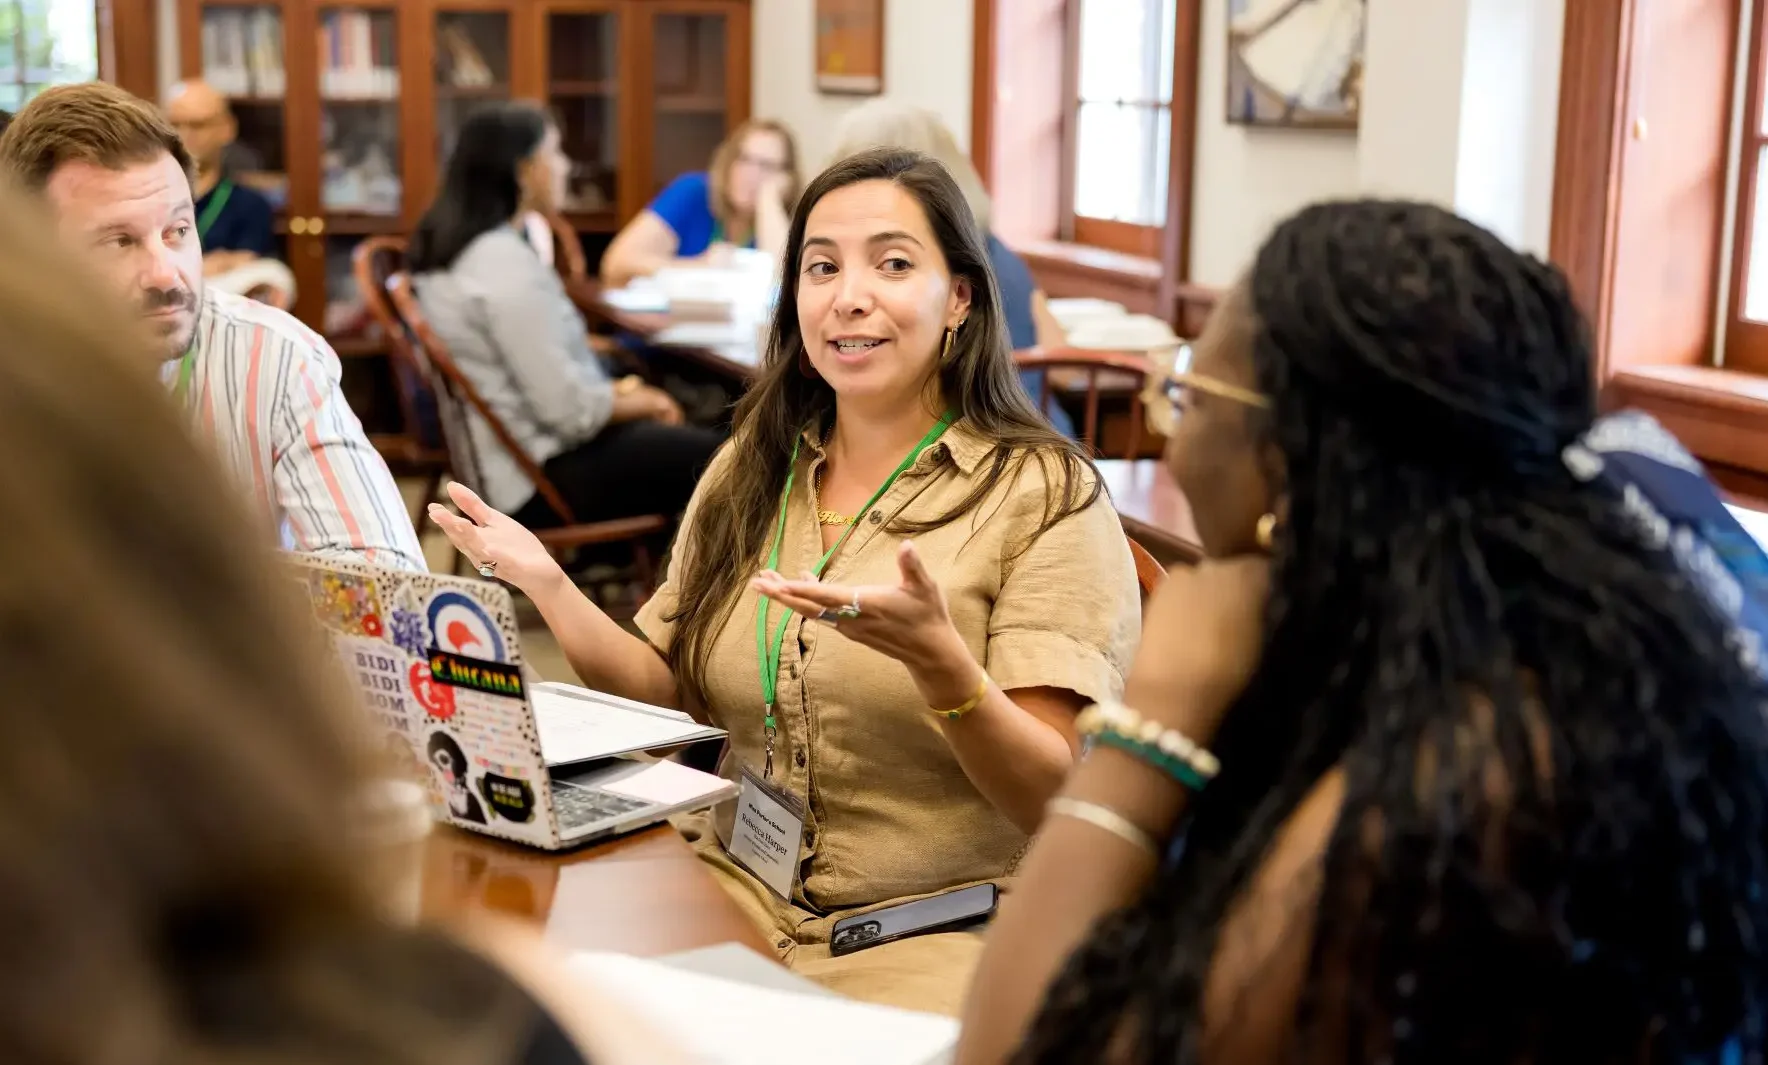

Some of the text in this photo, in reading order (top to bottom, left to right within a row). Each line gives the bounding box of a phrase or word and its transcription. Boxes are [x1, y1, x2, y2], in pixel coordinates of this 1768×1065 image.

[355, 652, 397, 673] BIDI
[360, 672, 402, 693] BIDI
[741, 811, 765, 838] Rebecca
[764, 833, 788, 856] Harper
[772, 821, 786, 835] School
